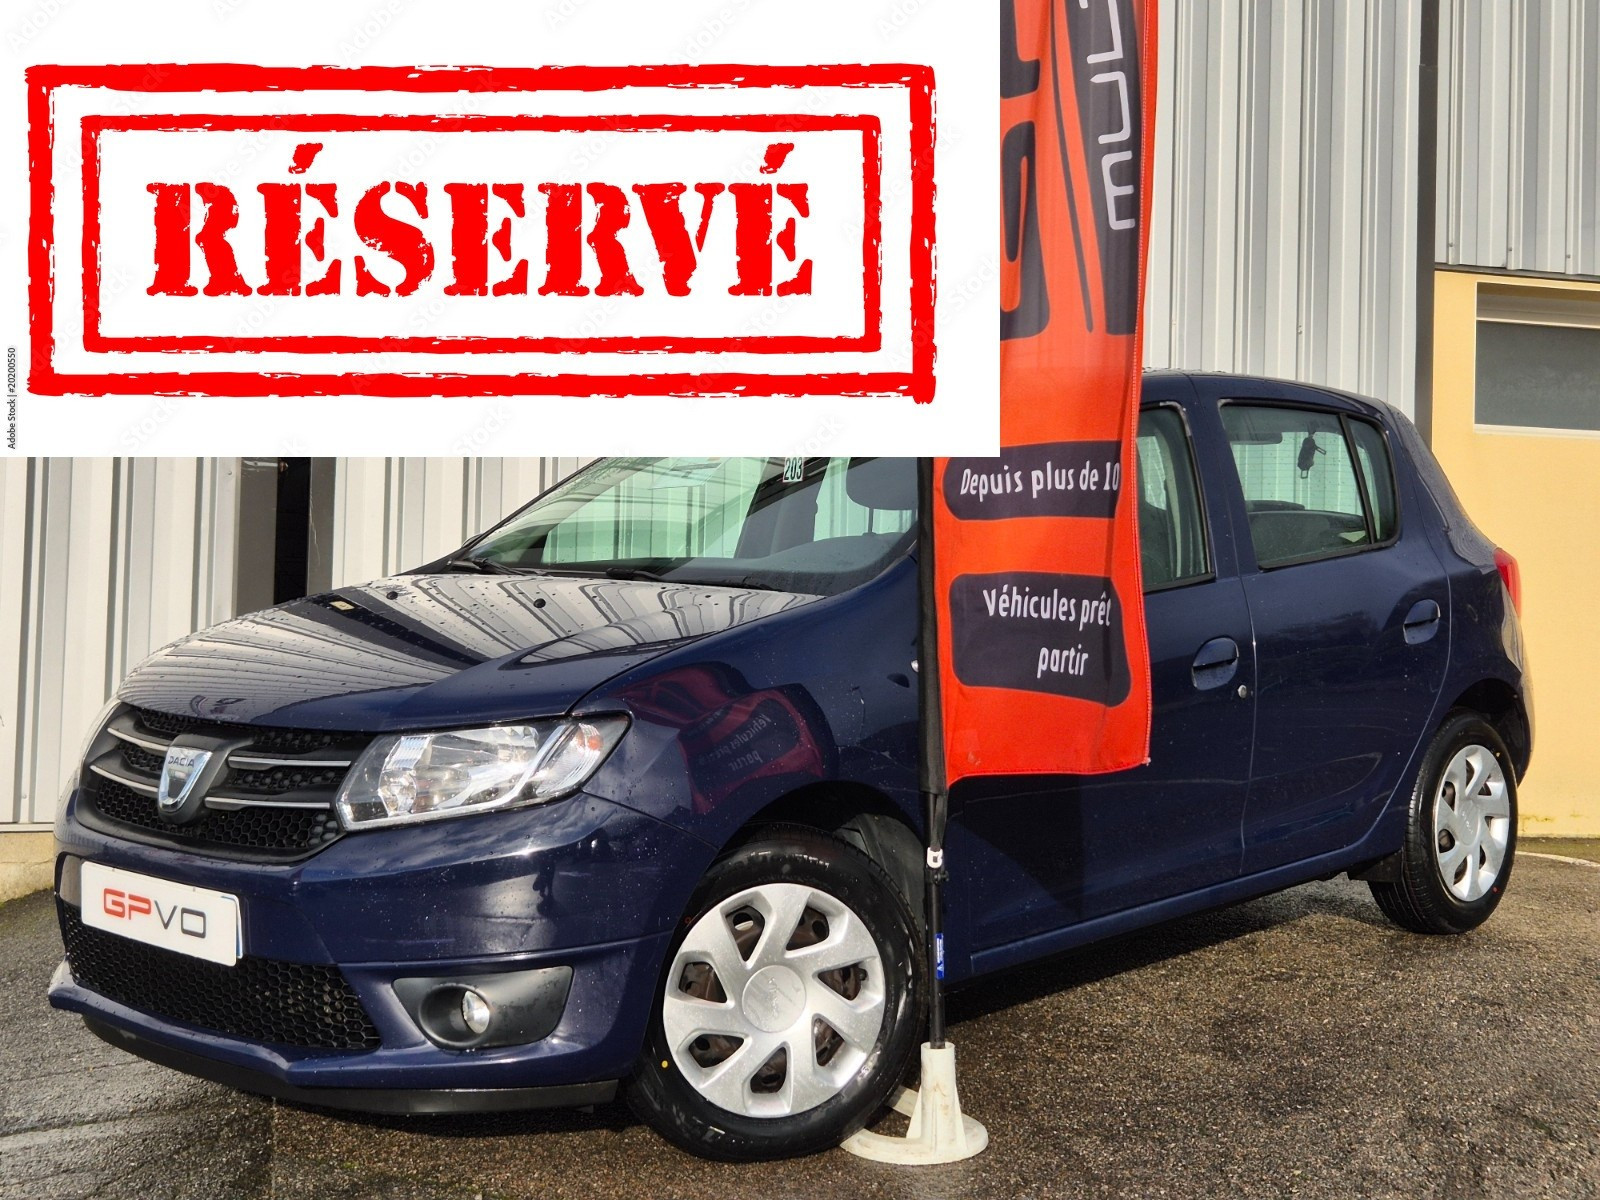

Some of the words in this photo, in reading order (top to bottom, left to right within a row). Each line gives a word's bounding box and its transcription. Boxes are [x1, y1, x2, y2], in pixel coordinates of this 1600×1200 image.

[783, 457, 803, 480] 203
[959, 464, 1023, 502] Depuis
[1031, 460, 1075, 498] plus
[1079, 460, 1099, 491] de
[1103, 461, 1120, 491] 10
[983, 584, 1076, 621] Véhicules
[1036, 644, 1089, 679] partir
[168, 755, 195, 768] DACIA
[103, 888, 207, 939] GPVO
